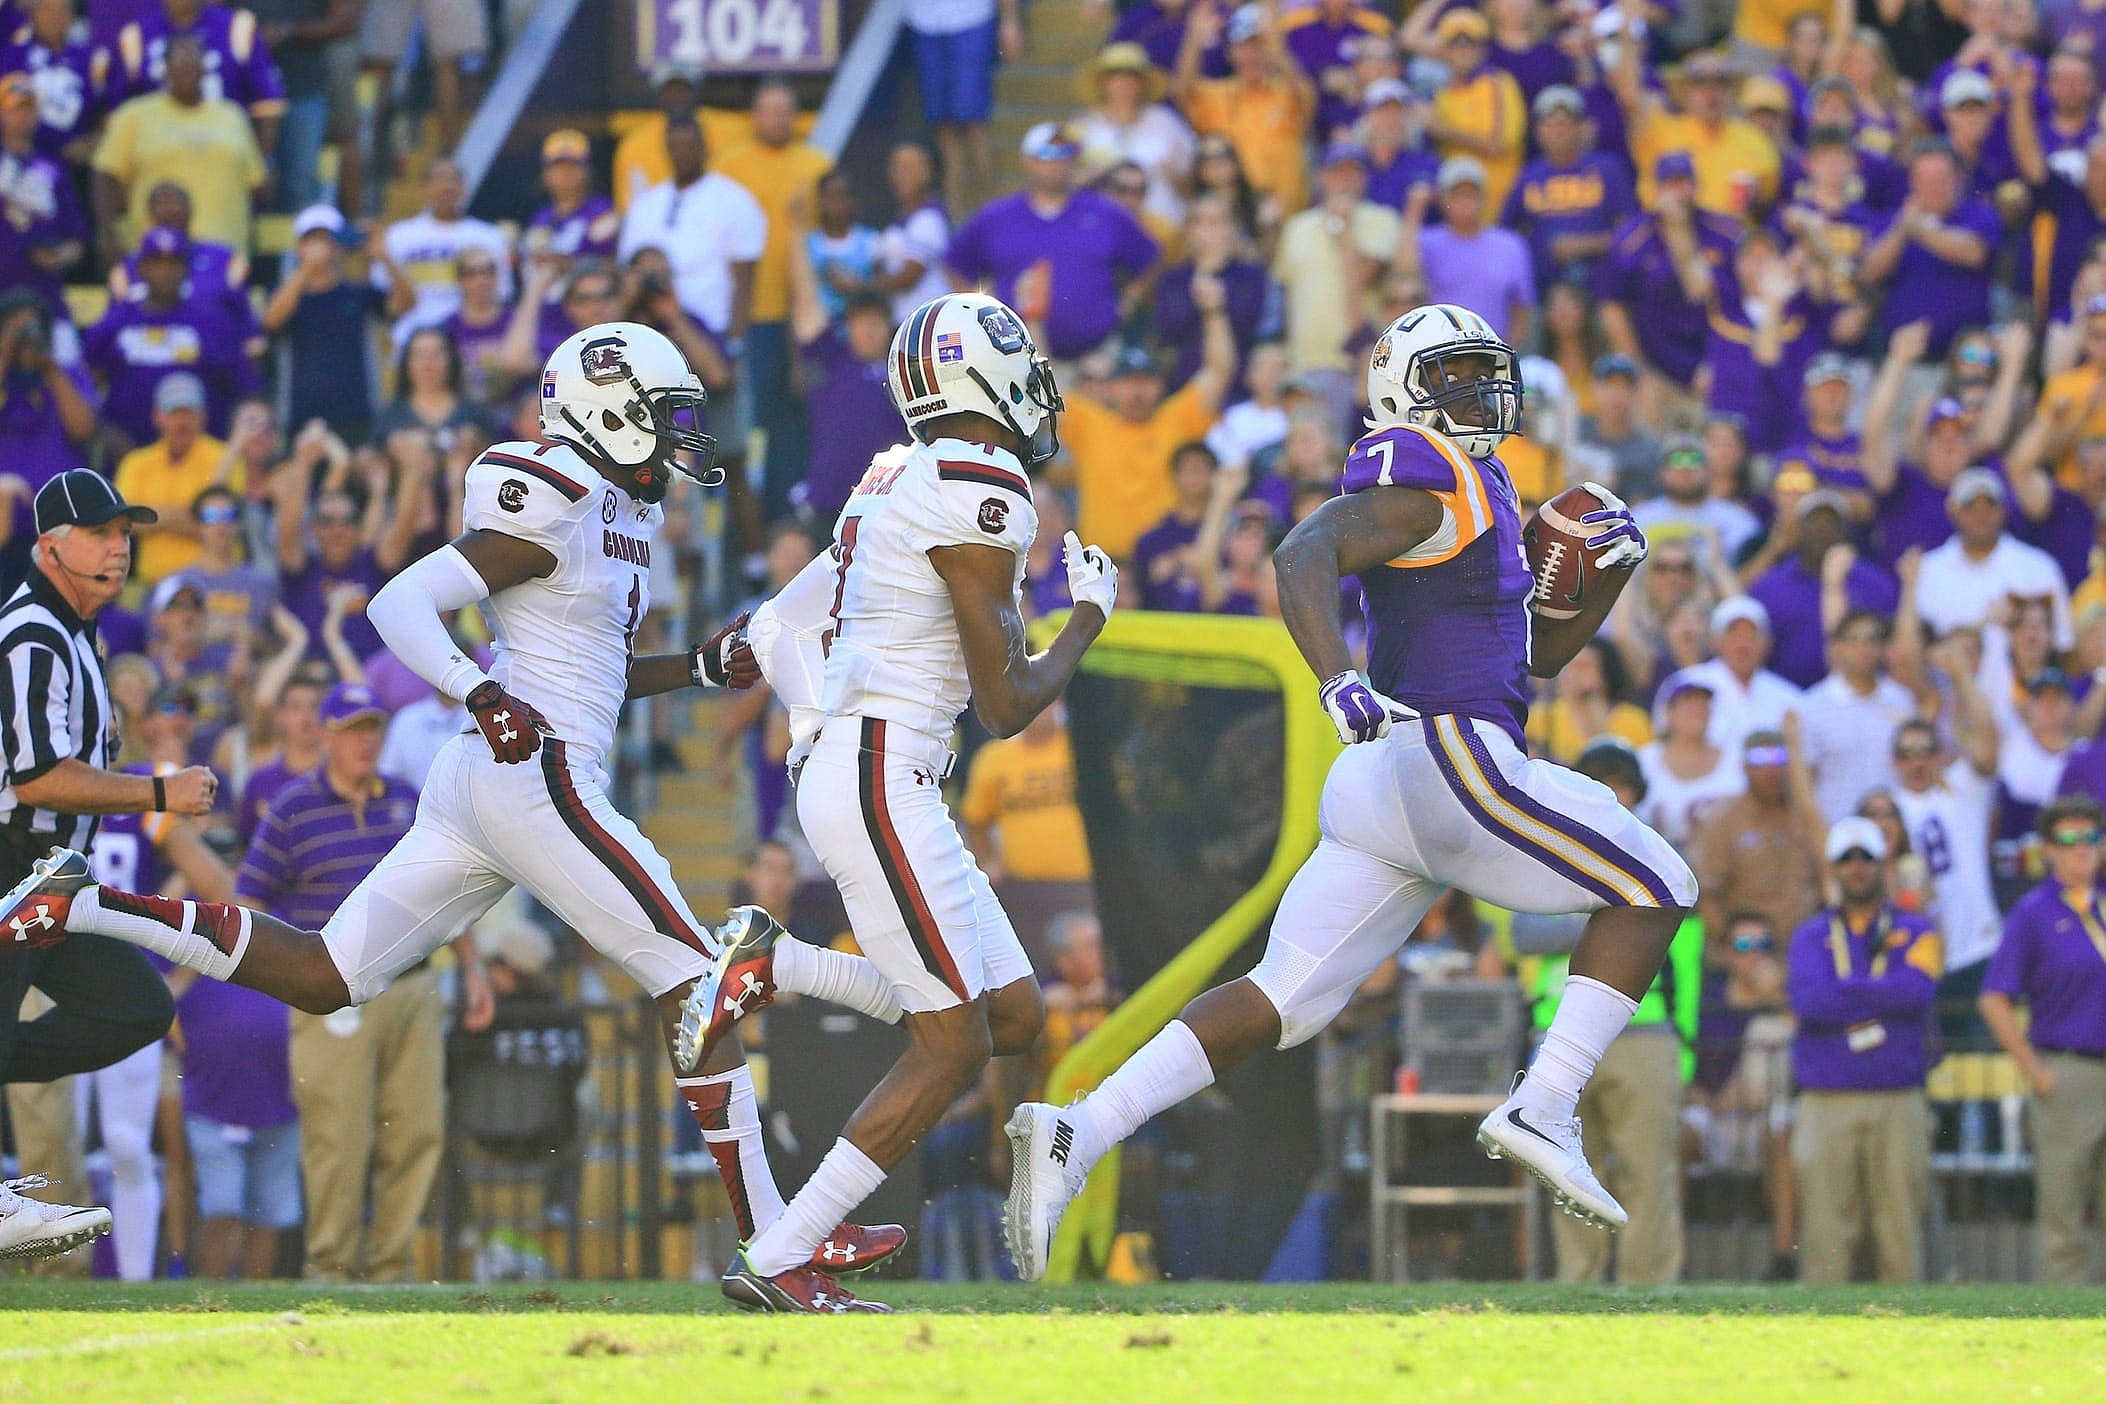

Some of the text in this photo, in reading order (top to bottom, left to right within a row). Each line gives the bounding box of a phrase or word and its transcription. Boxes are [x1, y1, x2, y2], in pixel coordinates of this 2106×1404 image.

[668, 0, 810, 63] 104
[1366, 439, 1394, 486] 7
[603, 529, 651, 569] CAROLIN
[1049, 1118, 1074, 1168] NIKE
